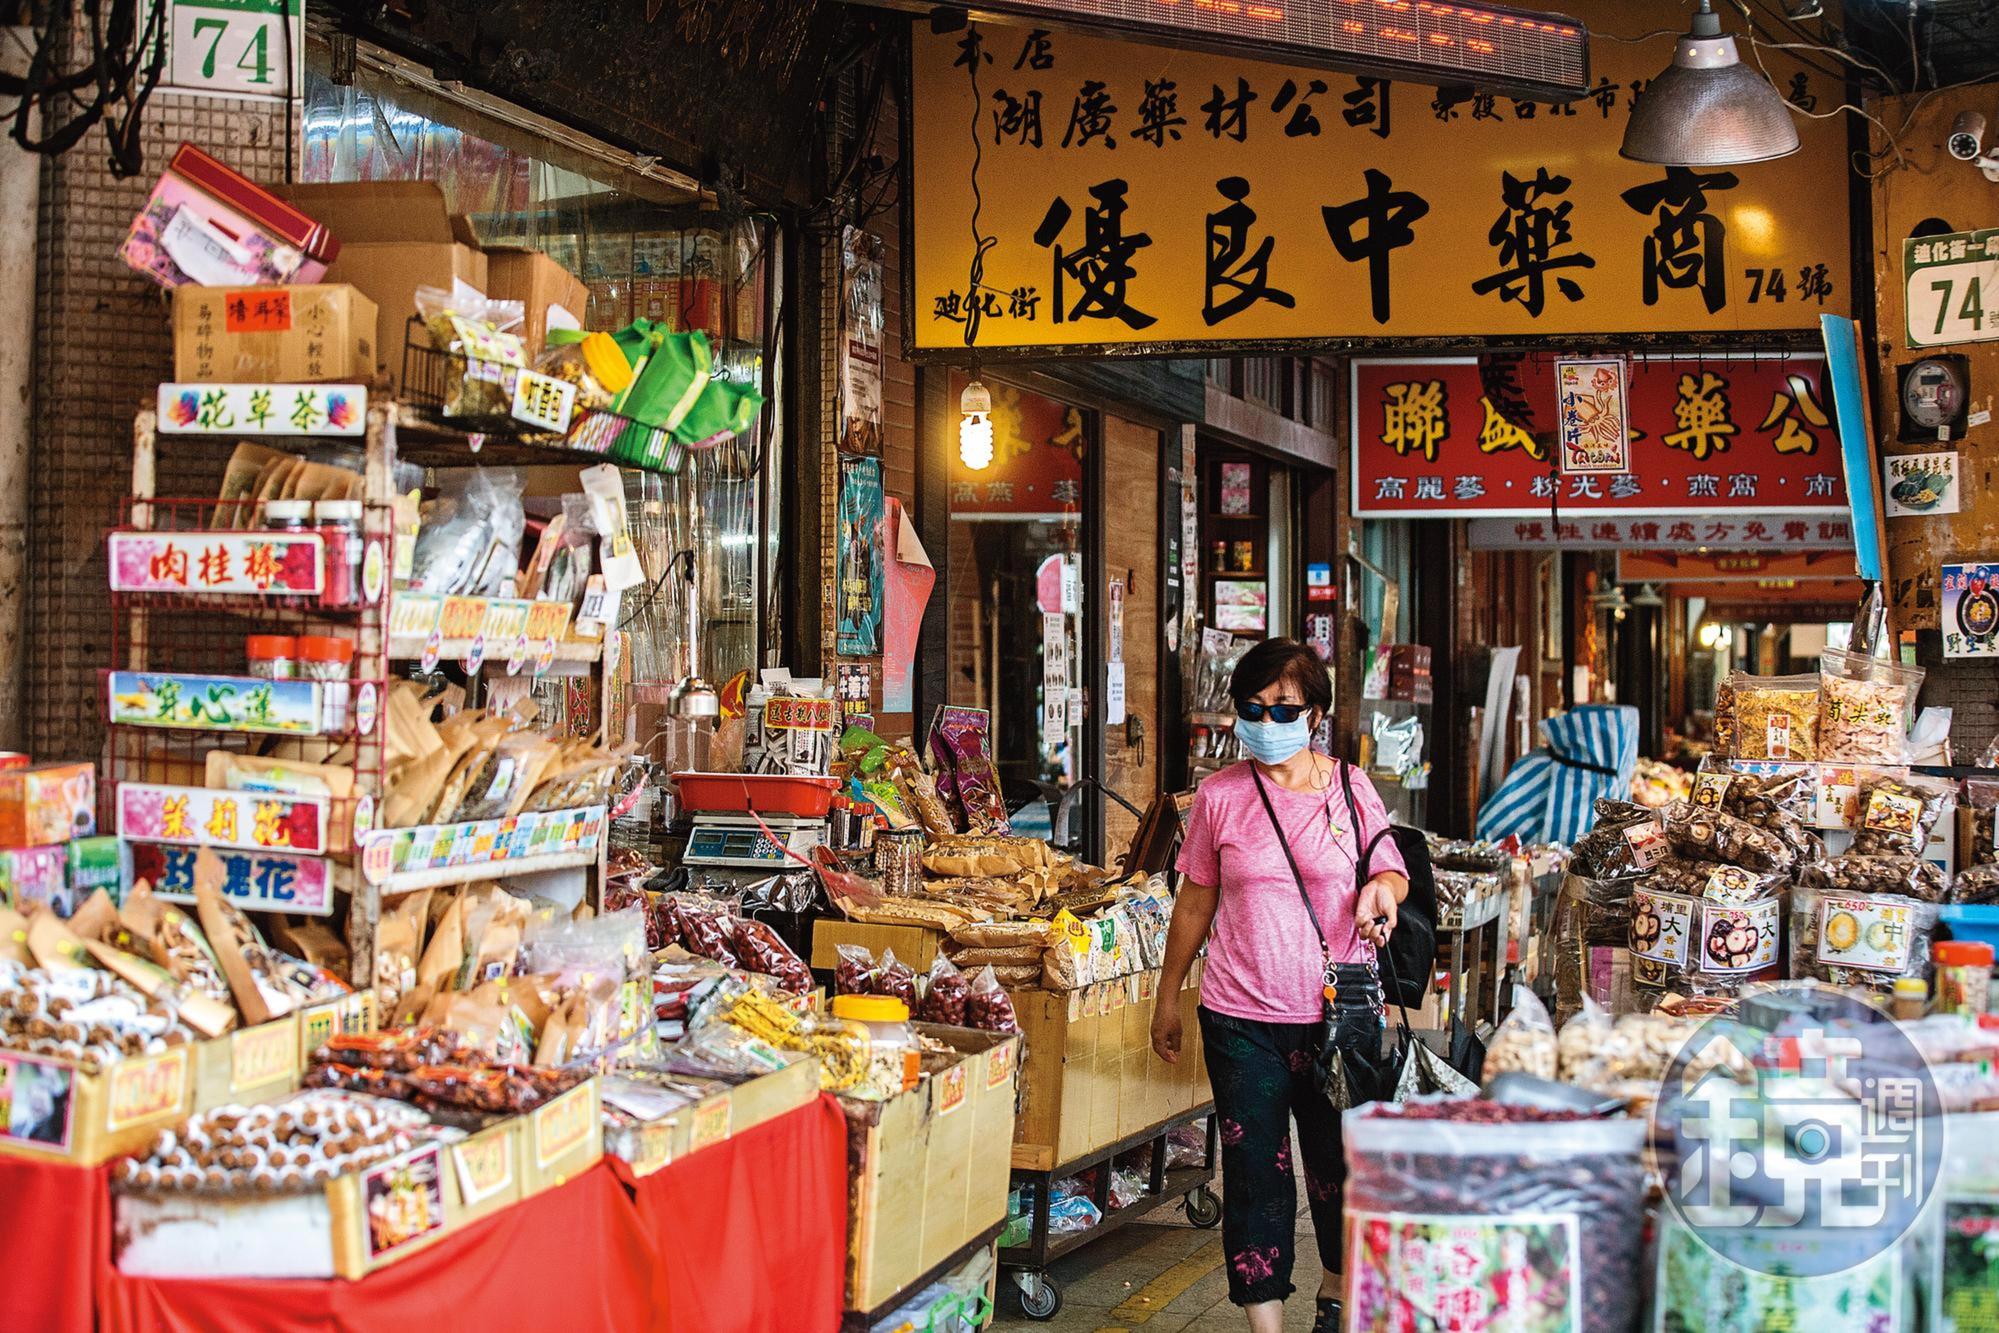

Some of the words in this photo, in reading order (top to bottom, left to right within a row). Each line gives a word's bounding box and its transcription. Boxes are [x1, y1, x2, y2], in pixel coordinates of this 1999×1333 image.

[193, 18, 275, 84] 74
[953, 23, 1055, 73] 本店
[991, 76, 1392, 149] 湖廣藥材公司
[1034, 166, 1740, 330] 優良中藥商
[933, 286, 1042, 322] 迪化街
[1745, 264, 1833, 305] 74號
[1931, 277, 1984, 334] 74
[198, 388, 325, 431] 花草茶
[150, 542, 283, 589] 肉桂棒
[155, 678, 273, 723] 穿心蓮
[161, 794, 291, 846] 茉莉花
[165, 850, 298, 900] 玫瑰花
